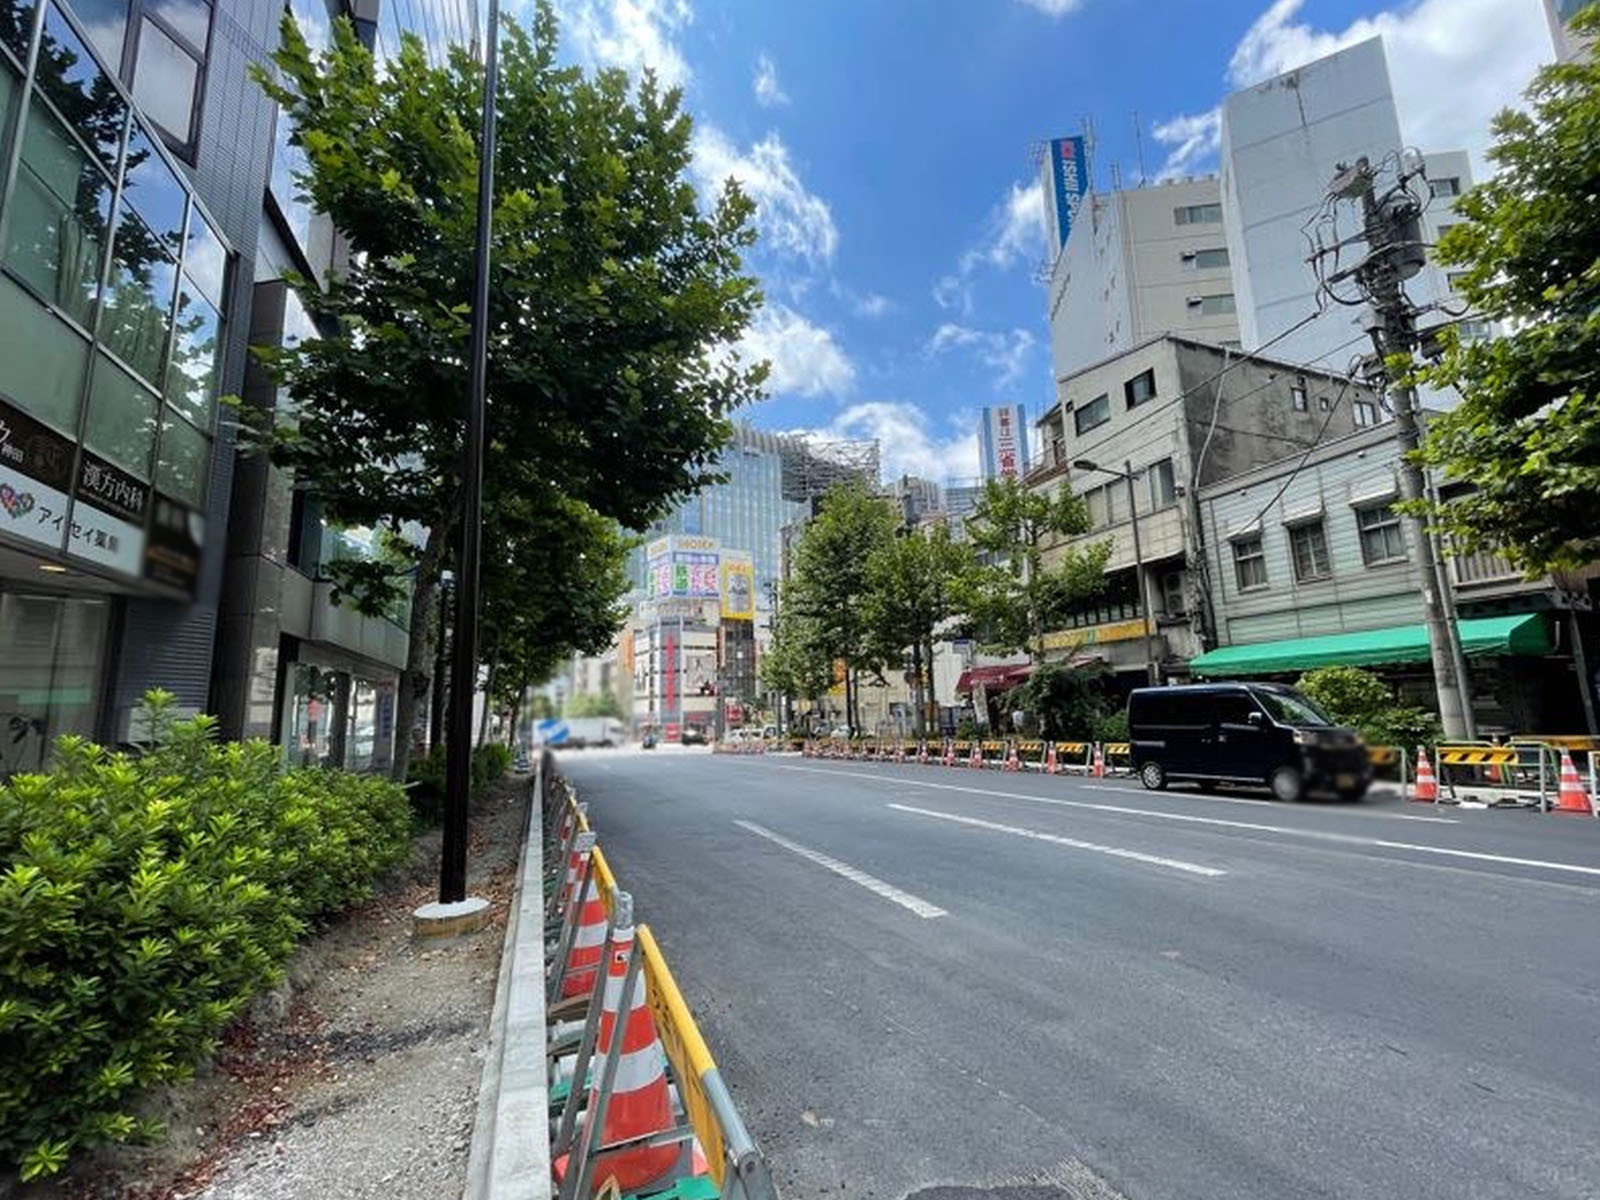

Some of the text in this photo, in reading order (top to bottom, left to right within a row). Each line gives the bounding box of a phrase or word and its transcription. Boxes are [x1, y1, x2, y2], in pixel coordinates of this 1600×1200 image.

[1062, 160, 1079, 190] ISHII
[83, 460, 143, 511] 漢方内科
